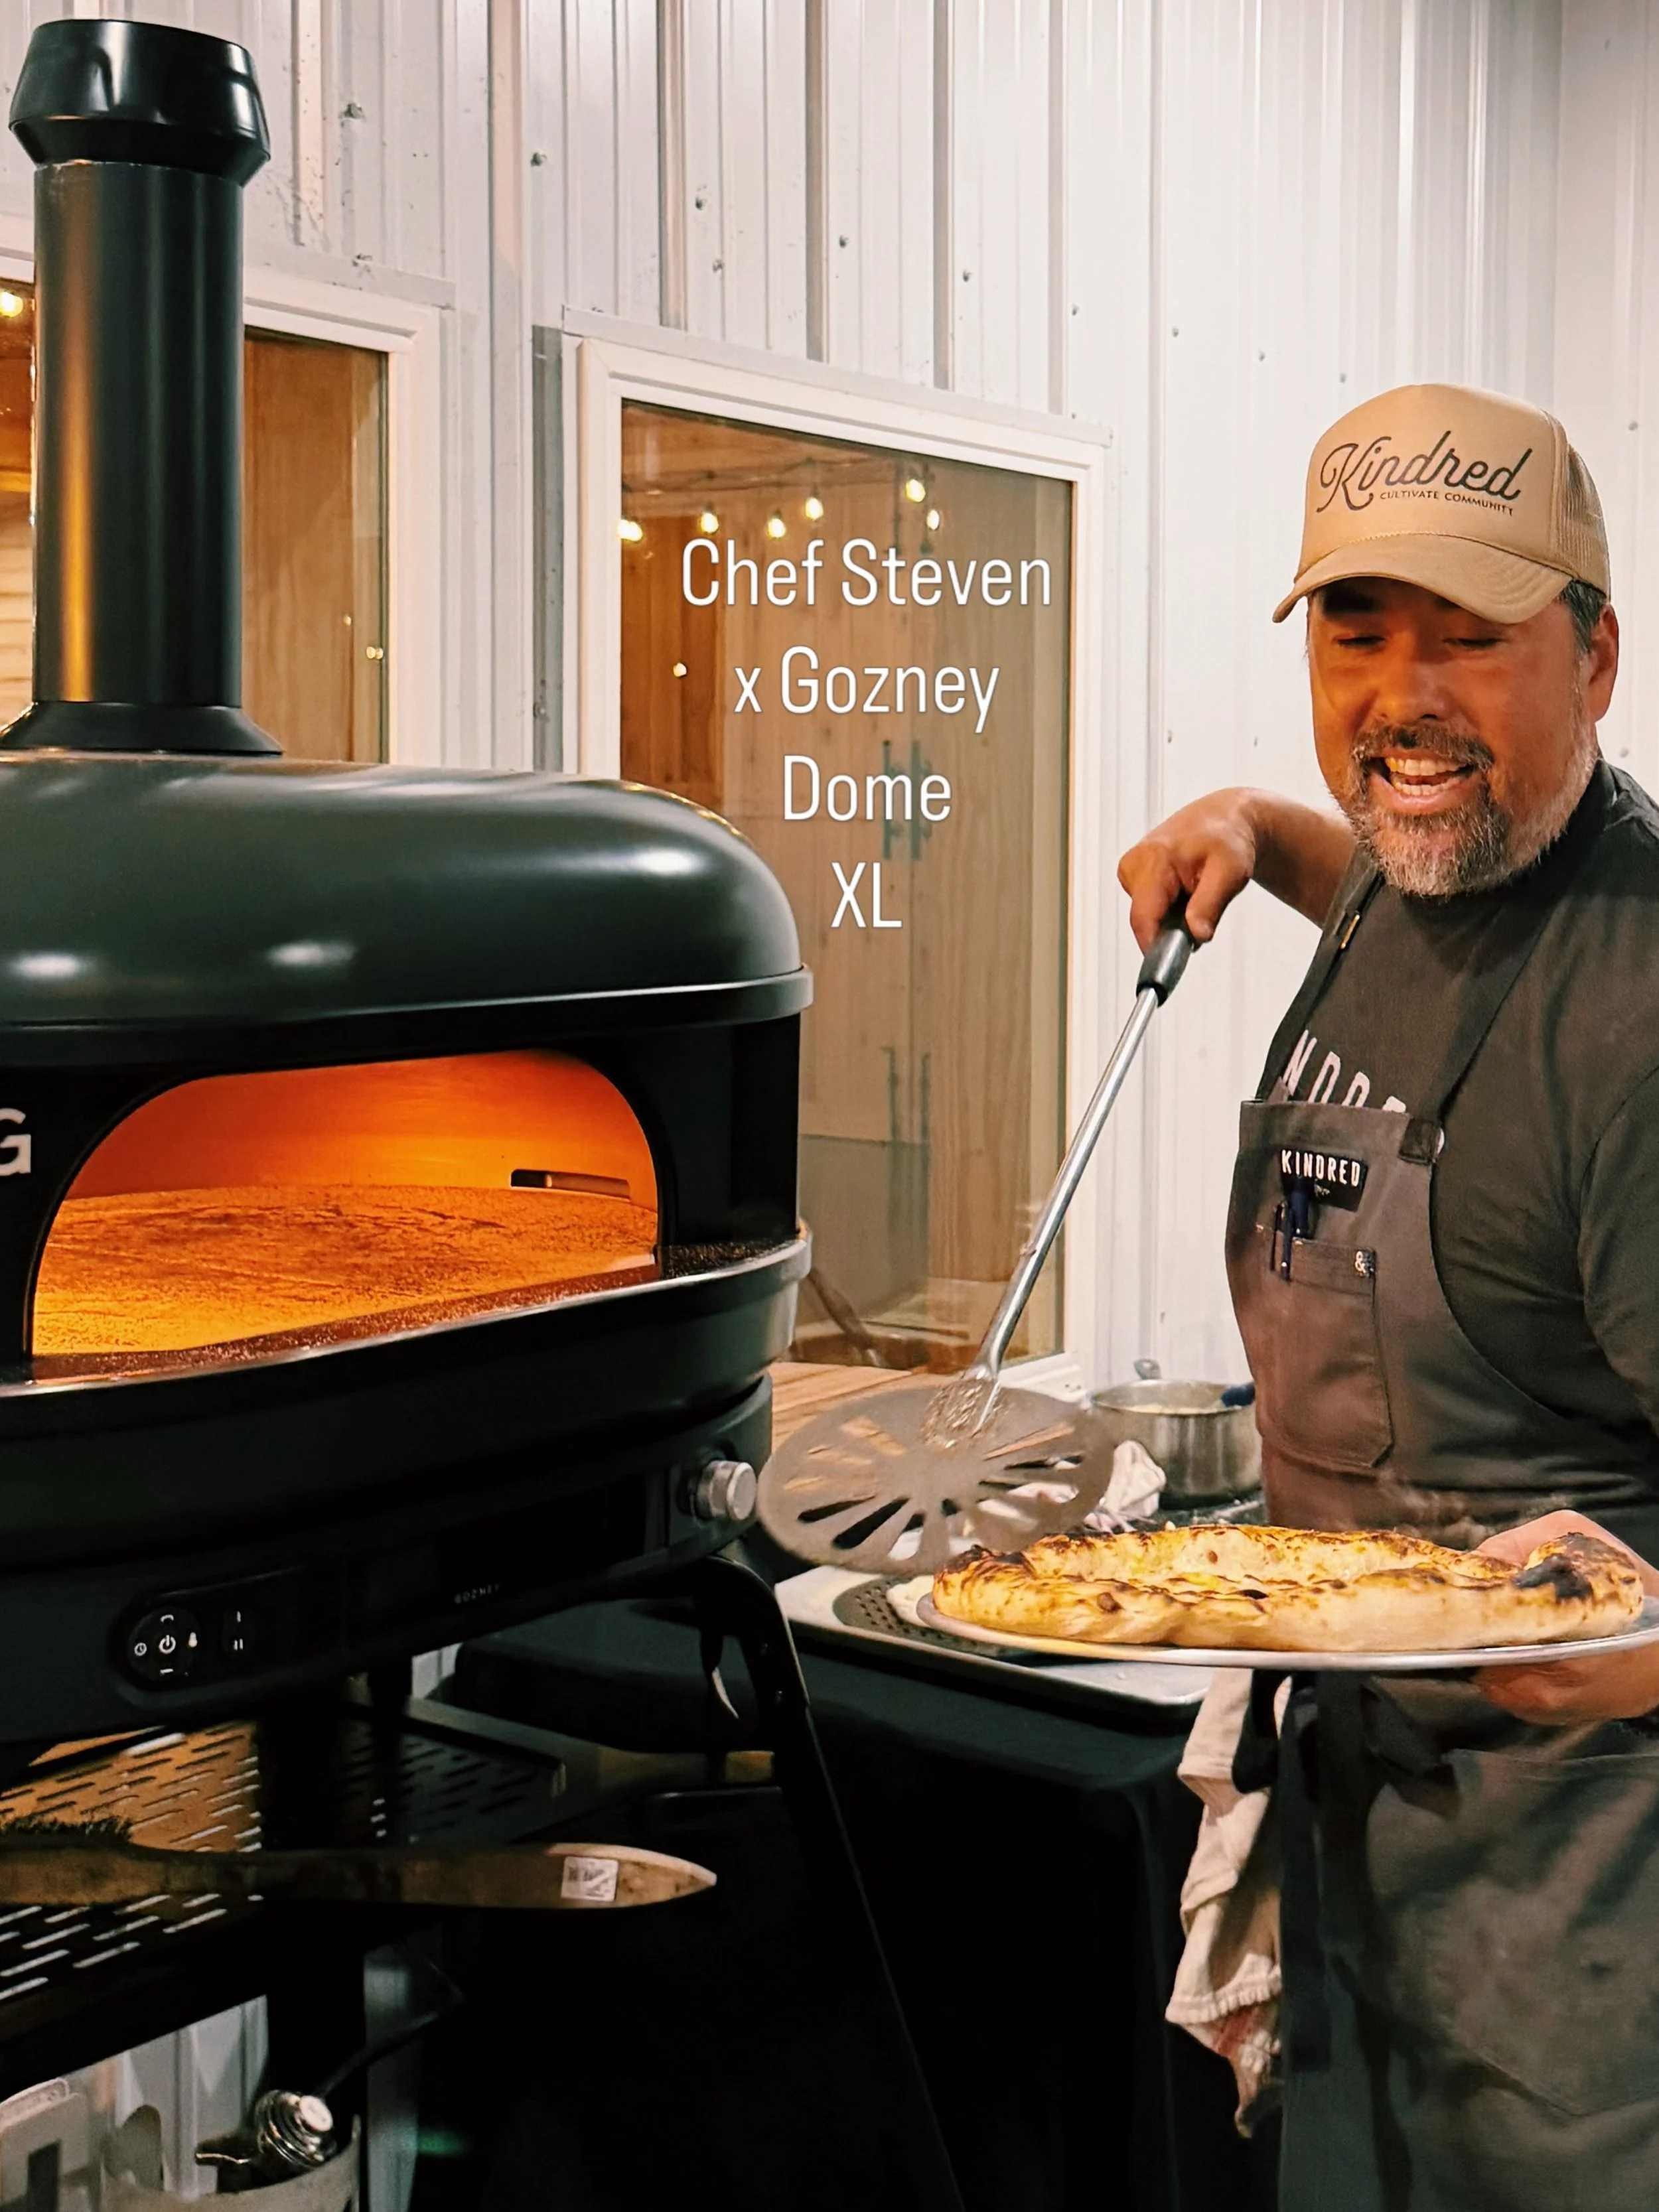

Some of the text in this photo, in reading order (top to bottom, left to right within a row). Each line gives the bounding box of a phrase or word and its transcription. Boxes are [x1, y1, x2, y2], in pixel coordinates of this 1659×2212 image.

[1317, 430, 1533, 513] Kindred
[1380, 490, 1514, 516] CULTIVATE COMMUNITY
[1281, 1149, 1360, 1187] KINDRED
